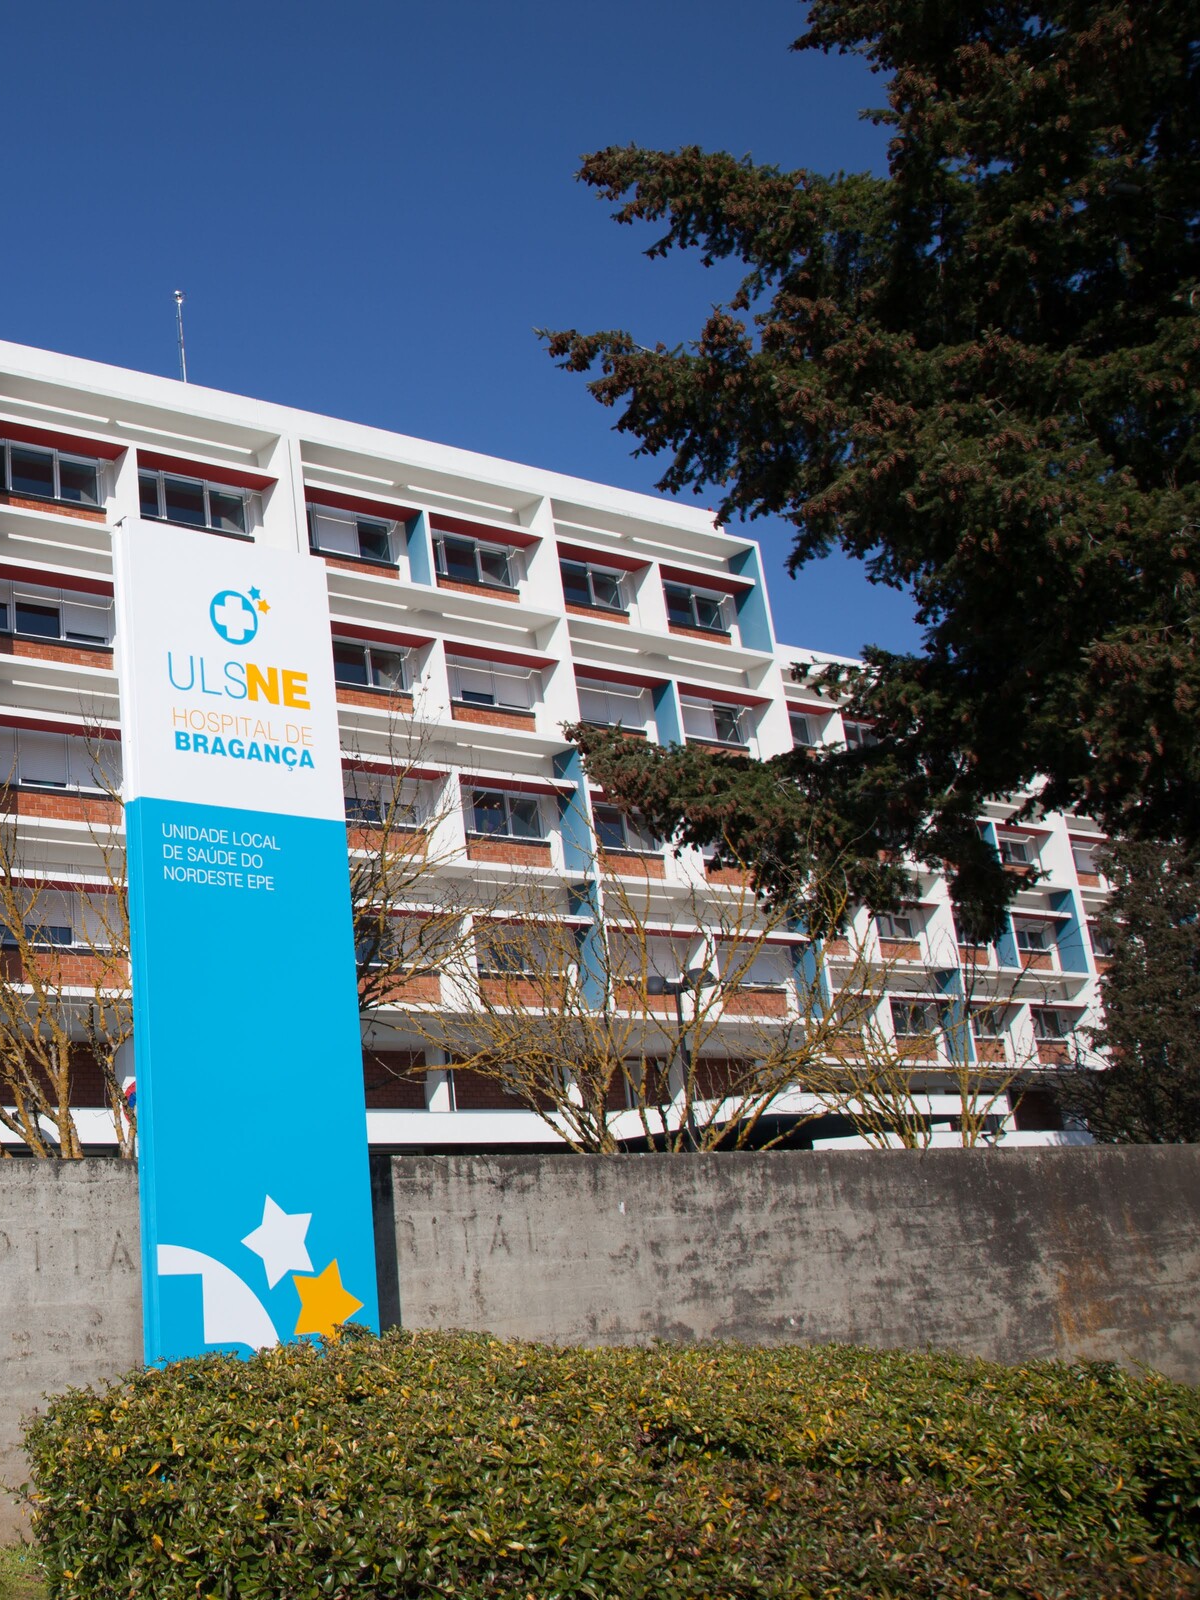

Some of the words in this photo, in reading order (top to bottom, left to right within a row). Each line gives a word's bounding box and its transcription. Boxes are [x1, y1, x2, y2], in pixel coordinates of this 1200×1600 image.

[168, 652, 311, 710] ULSNE
[173, 707, 279, 742] HOSPITAL
[285, 724, 314, 747] DE
[175, 731, 315, 771] BRAGANÇA
[162, 823, 229, 844] UNIDADE
[233, 832, 281, 850] LOCAL
[163, 844, 183, 860] DE
[187, 846, 237, 866] SAÚDE
[241, 853, 263, 869] DO
[163, 866, 244, 888] NORDESTE
[247, 874, 275, 890] EPE
